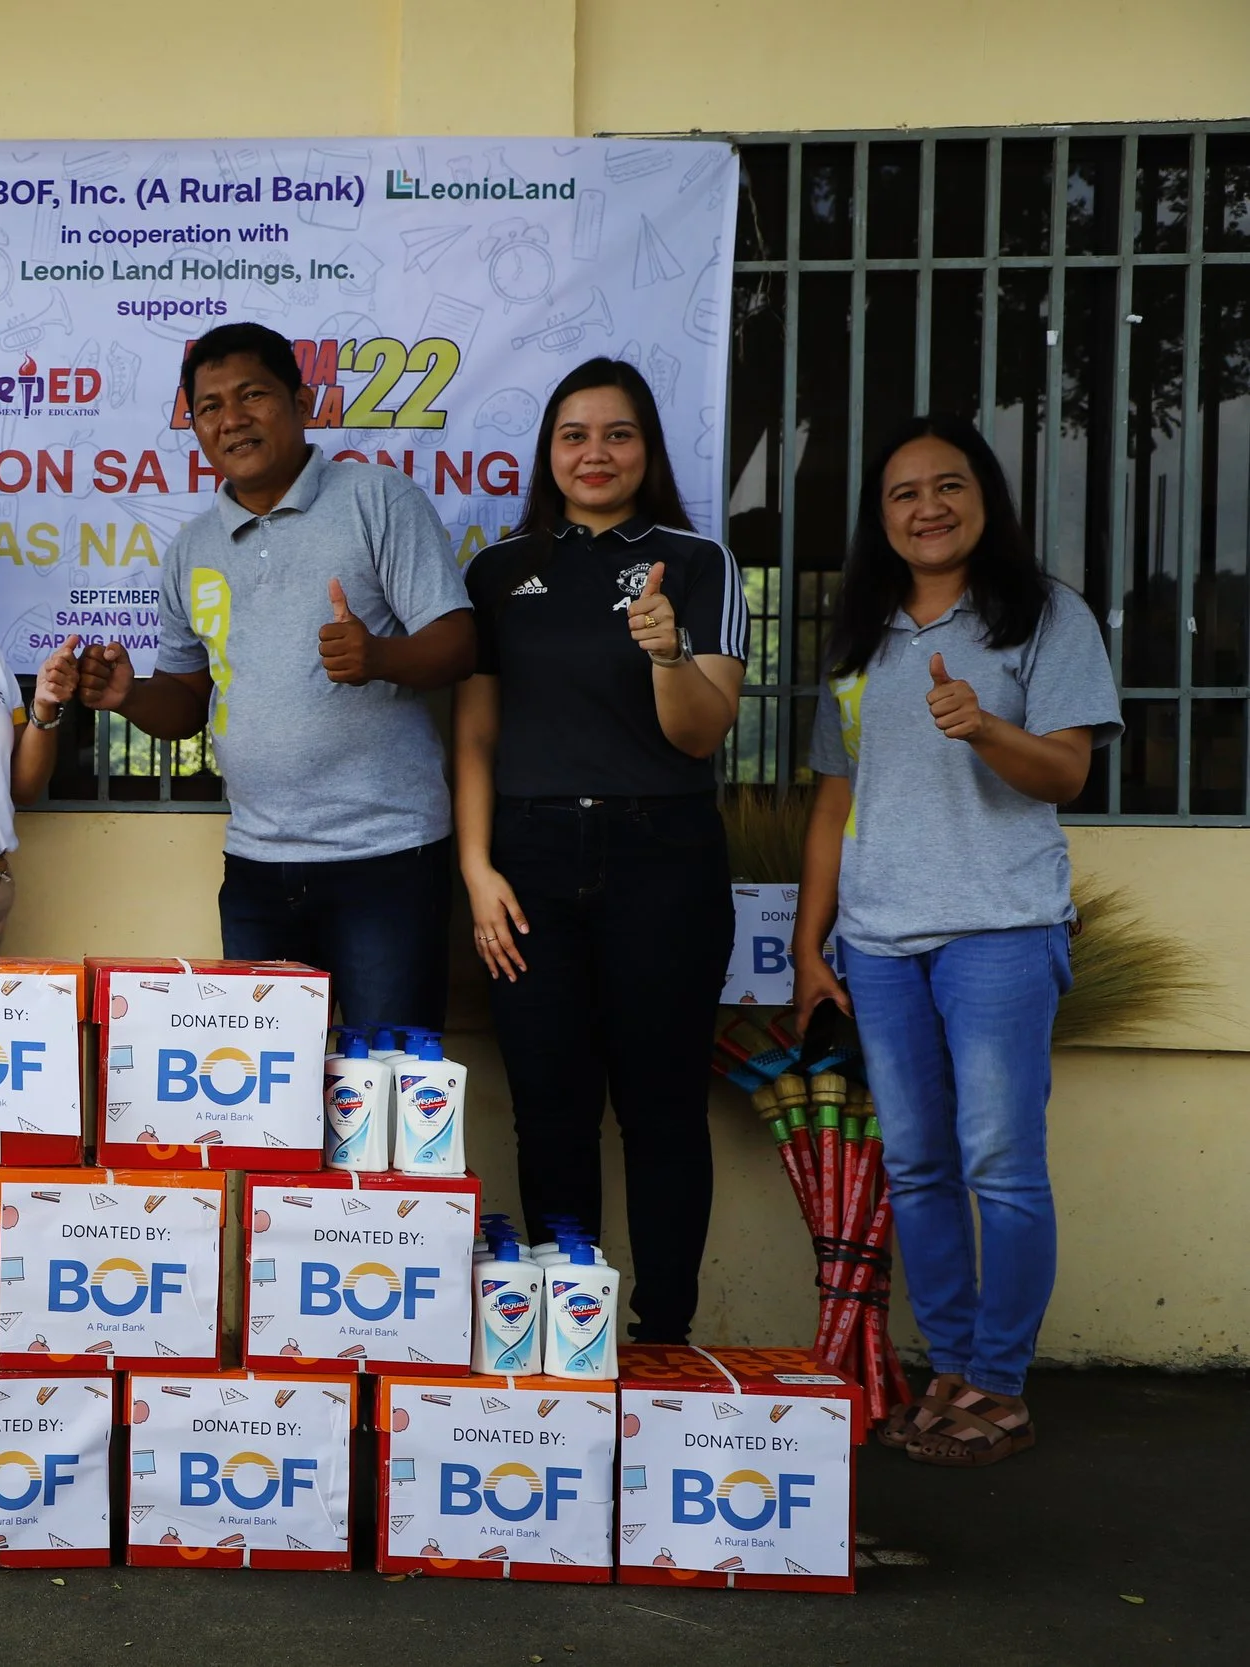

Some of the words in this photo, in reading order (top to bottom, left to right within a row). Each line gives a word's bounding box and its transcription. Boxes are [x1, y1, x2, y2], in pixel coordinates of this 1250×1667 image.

[70, 179, 126, 205] Inc.
[136, 178, 170, 210] (A
[180, 177, 261, 203] Rural
[272, 175, 365, 207] Bank)
[414, 177, 575, 200] LeonioLand
[61, 225, 81, 244] in
[88, 224, 231, 248] cooperation
[238, 223, 289, 242] with
[21, 260, 104, 281] Leonio
[113, 259, 173, 280] Land
[182, 258, 301, 285] Holdings,
[310, 259, 355, 280] Inc.
[117, 296, 227, 321] supports
[48, 409, 100, 417] EDUCATION
[93, 449, 170, 494] SA
[435, 451, 519, 496] NG
[80, 522, 160, 567] NA
[70, 590, 159, 604] SEPTEMBER
[511, 586, 548, 595] adidas
[56, 611, 131, 626] SAPANG
[29, 633, 104, 649] SAPNG
[761, 911, 798, 922] DONA
[4, 1008, 29, 1021] BY:
[171, 1014, 249, 1029] DONATED
[254, 1016, 279, 1030] BY:
[157, 1047, 295, 1106] BOF
[330, 1092, 365, 1106] Safeguard
[409, 1092, 449, 1107] Safeguard
[195, 1112, 203, 1120] A
[205, 1112, 228, 1121] Rural
[230, 1112, 254, 1122] Bank
[62, 1224, 141, 1240] DONATED
[146, 1227, 171, 1241] BY:
[314, 1229, 394, 1245] DONATED
[399, 1231, 425, 1246] BY:
[48, 1257, 187, 1317] BOF
[300, 1262, 440, 1322] BOF
[490, 1297, 531, 1312] Safeguard
[560, 1300, 603, 1313] Safeguard
[86, 1323, 94, 1331] A
[96, 1323, 120, 1332] Rural
[122, 1323, 145, 1332] Bank
[339, 1326, 346, 1335] A
[349, 1326, 372, 1336] Rural
[375, 1327, 399, 1337] Bank
[38, 1418, 64, 1432] BY:
[192, 1419, 272, 1435] DONATED
[277, 1422, 302, 1436] BY:
[453, 1428, 534, 1445] DONATED
[539, 1431, 566, 1446] BY:
[684, 1433, 766, 1451] DONATED
[771, 1437, 799, 1452] BY:
[180, 1451, 318, 1511] BOF
[440, 1462, 582, 1522] BOF
[672, 1468, 815, 1531] BOF
[16, 1516, 39, 1526] Bank
[218, 1516, 226, 1524] A
[228, 1516, 252, 1525] Rural
[254, 1516, 277, 1526] Bank
[480, 1527, 487, 1535] A
[489, 1527, 514, 1536] Rural
[516, 1528, 541, 1538] Bank
[714, 1537, 722, 1546] A
[724, 1537, 749, 1547] Rural
[751, 1537, 775, 1548] Bank
